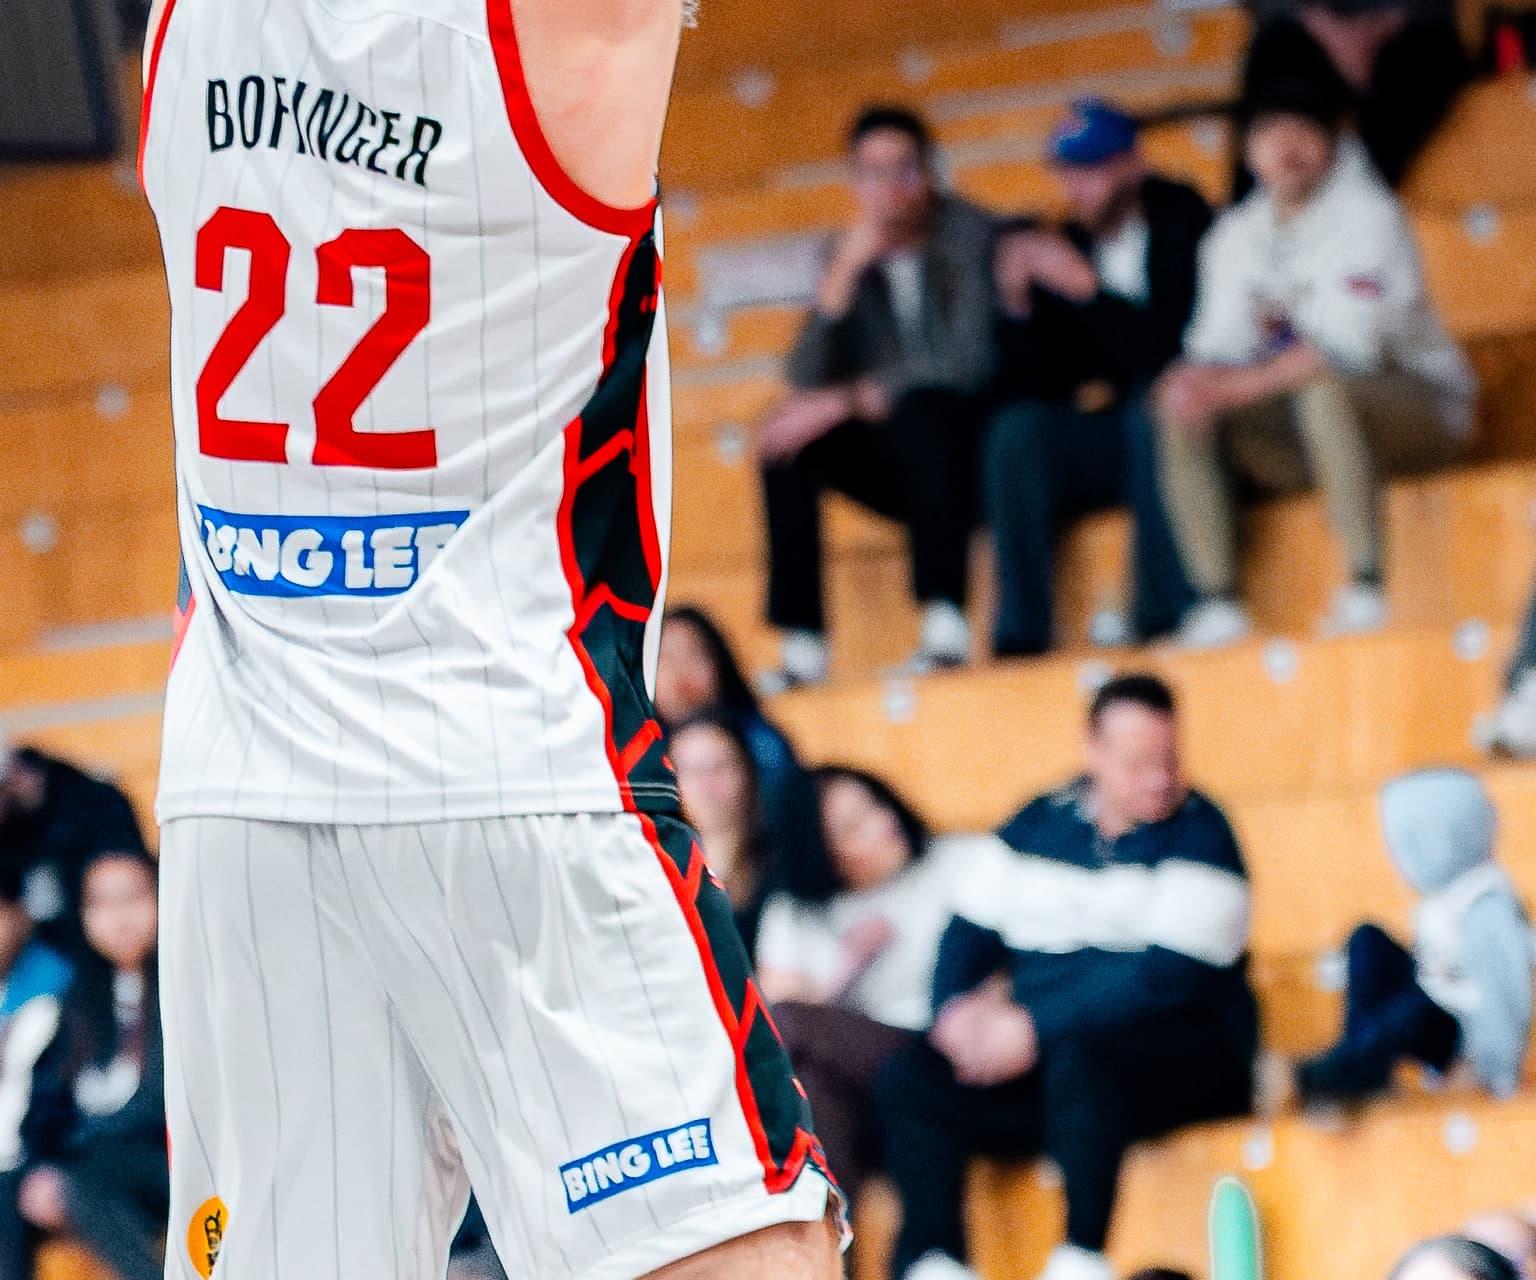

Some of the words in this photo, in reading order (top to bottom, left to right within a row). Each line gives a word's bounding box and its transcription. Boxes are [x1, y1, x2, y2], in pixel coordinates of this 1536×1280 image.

[208, 75, 442, 187] BOFINGER
[195, 206, 437, 470] 22
[562, 1144, 651, 1202] BING
[652, 1125, 710, 1169] LEE
